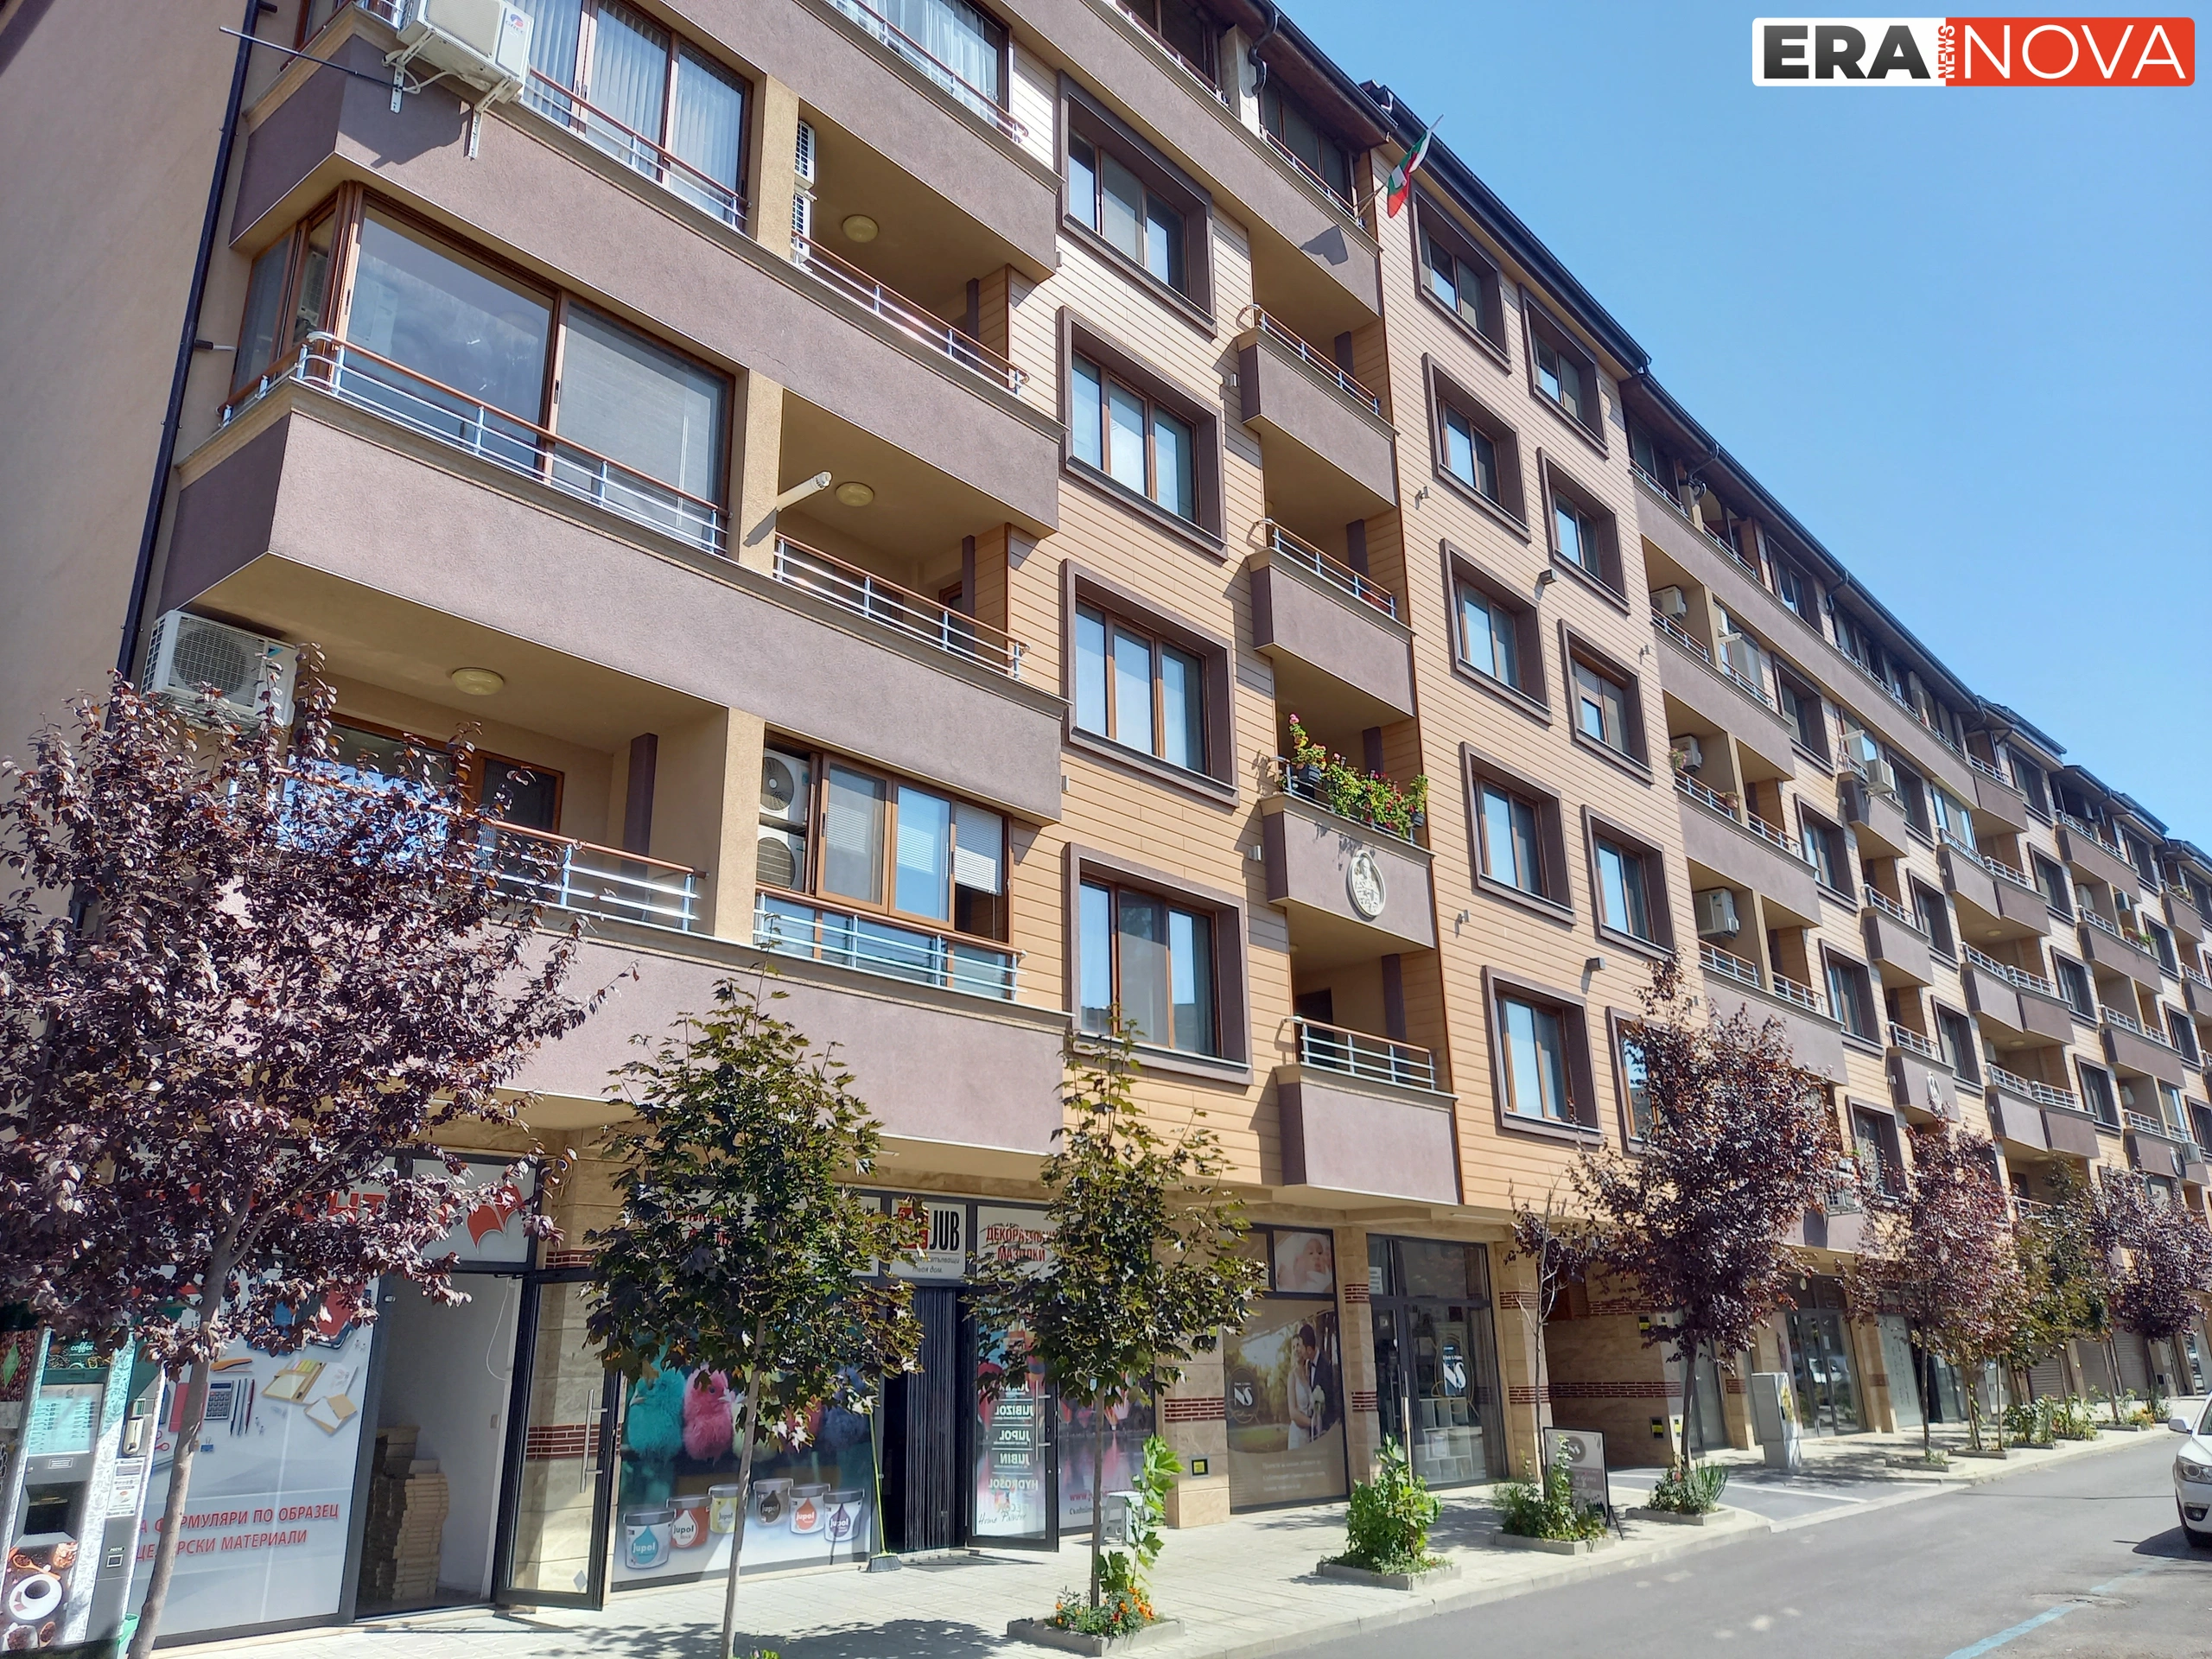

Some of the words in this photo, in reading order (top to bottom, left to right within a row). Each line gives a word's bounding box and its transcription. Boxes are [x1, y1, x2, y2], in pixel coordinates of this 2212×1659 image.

[929, 1210, 960, 1251] JUB
[70, 1341, 94, 1353] coffee
[253, 1509, 274, 1523] ПО
[278, 1503, 339, 1522] ОБРАЗЕЦ
[220, 1529, 308, 1551] МАТЕРИАЛИ
